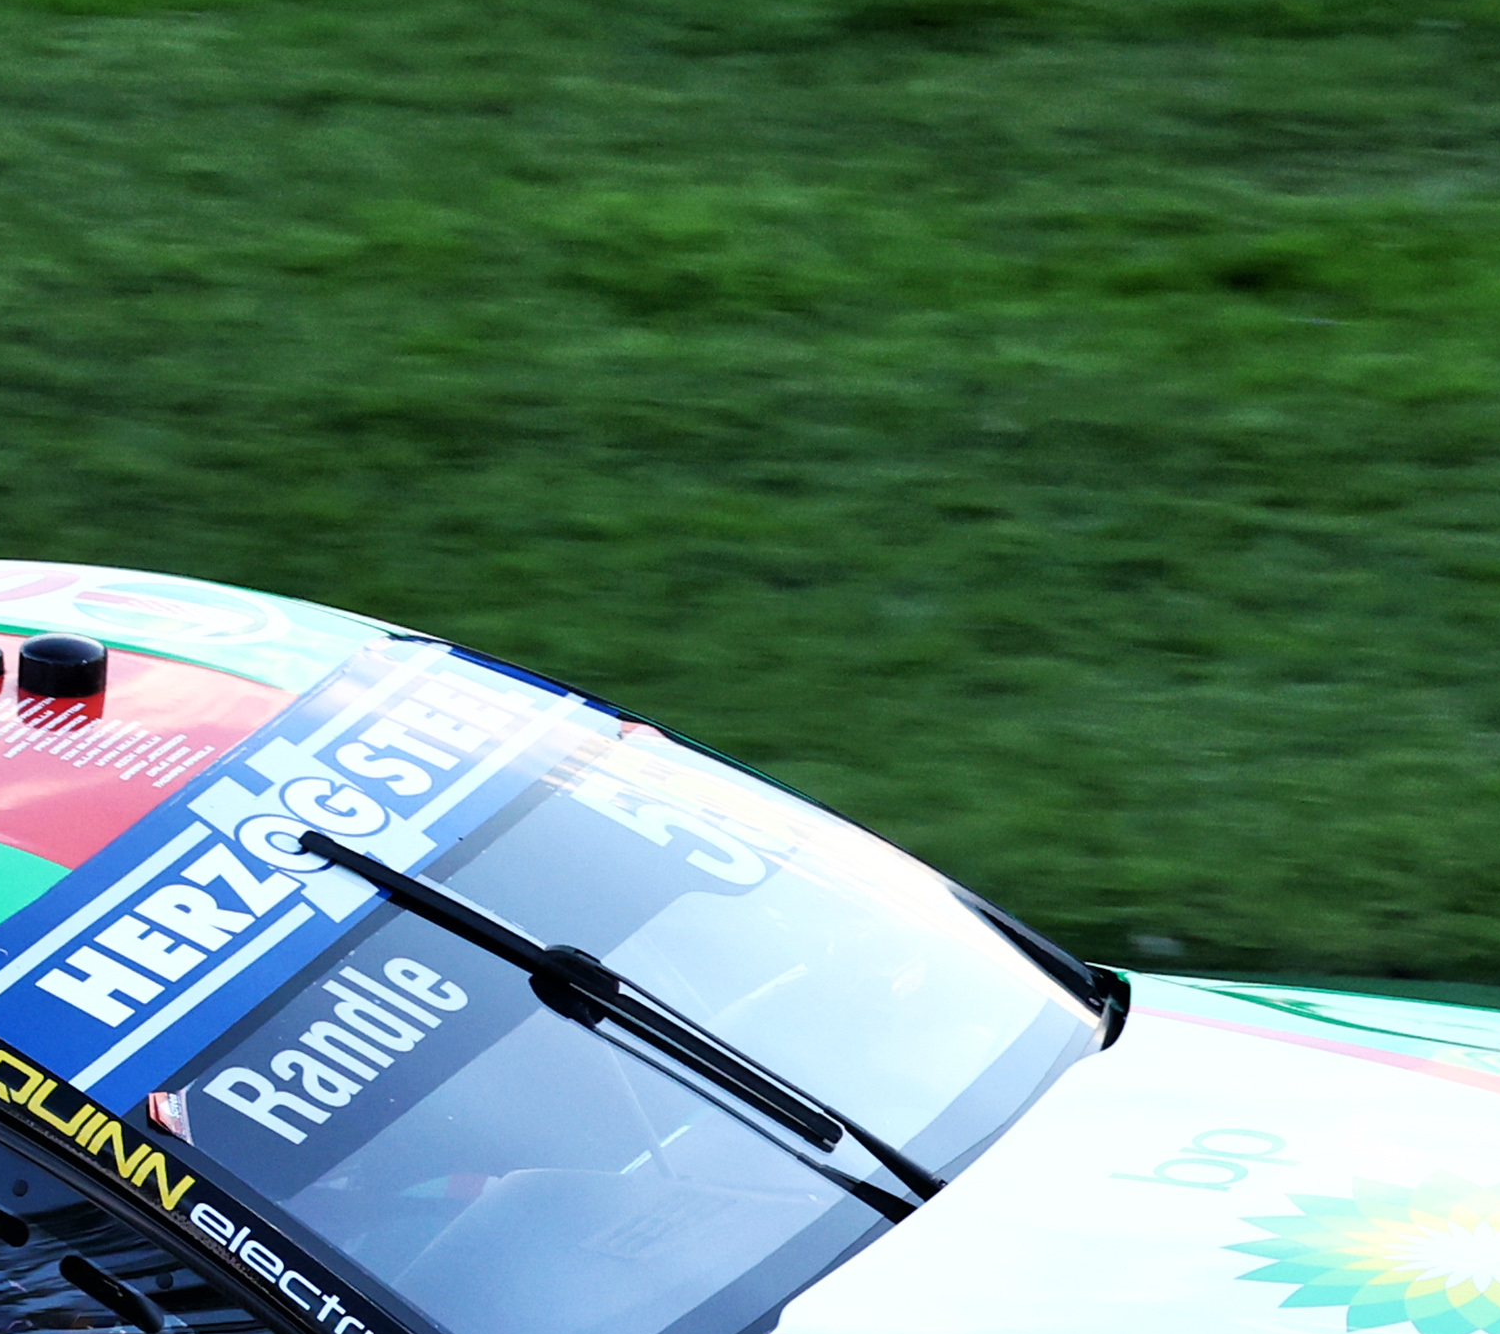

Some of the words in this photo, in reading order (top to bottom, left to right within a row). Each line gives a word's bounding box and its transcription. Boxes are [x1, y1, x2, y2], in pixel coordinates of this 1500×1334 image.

[35, 776, 391, 1028] HERZOG
[336, 670, 538, 796] STEEL
[203, 958, 468, 1144] Randle
